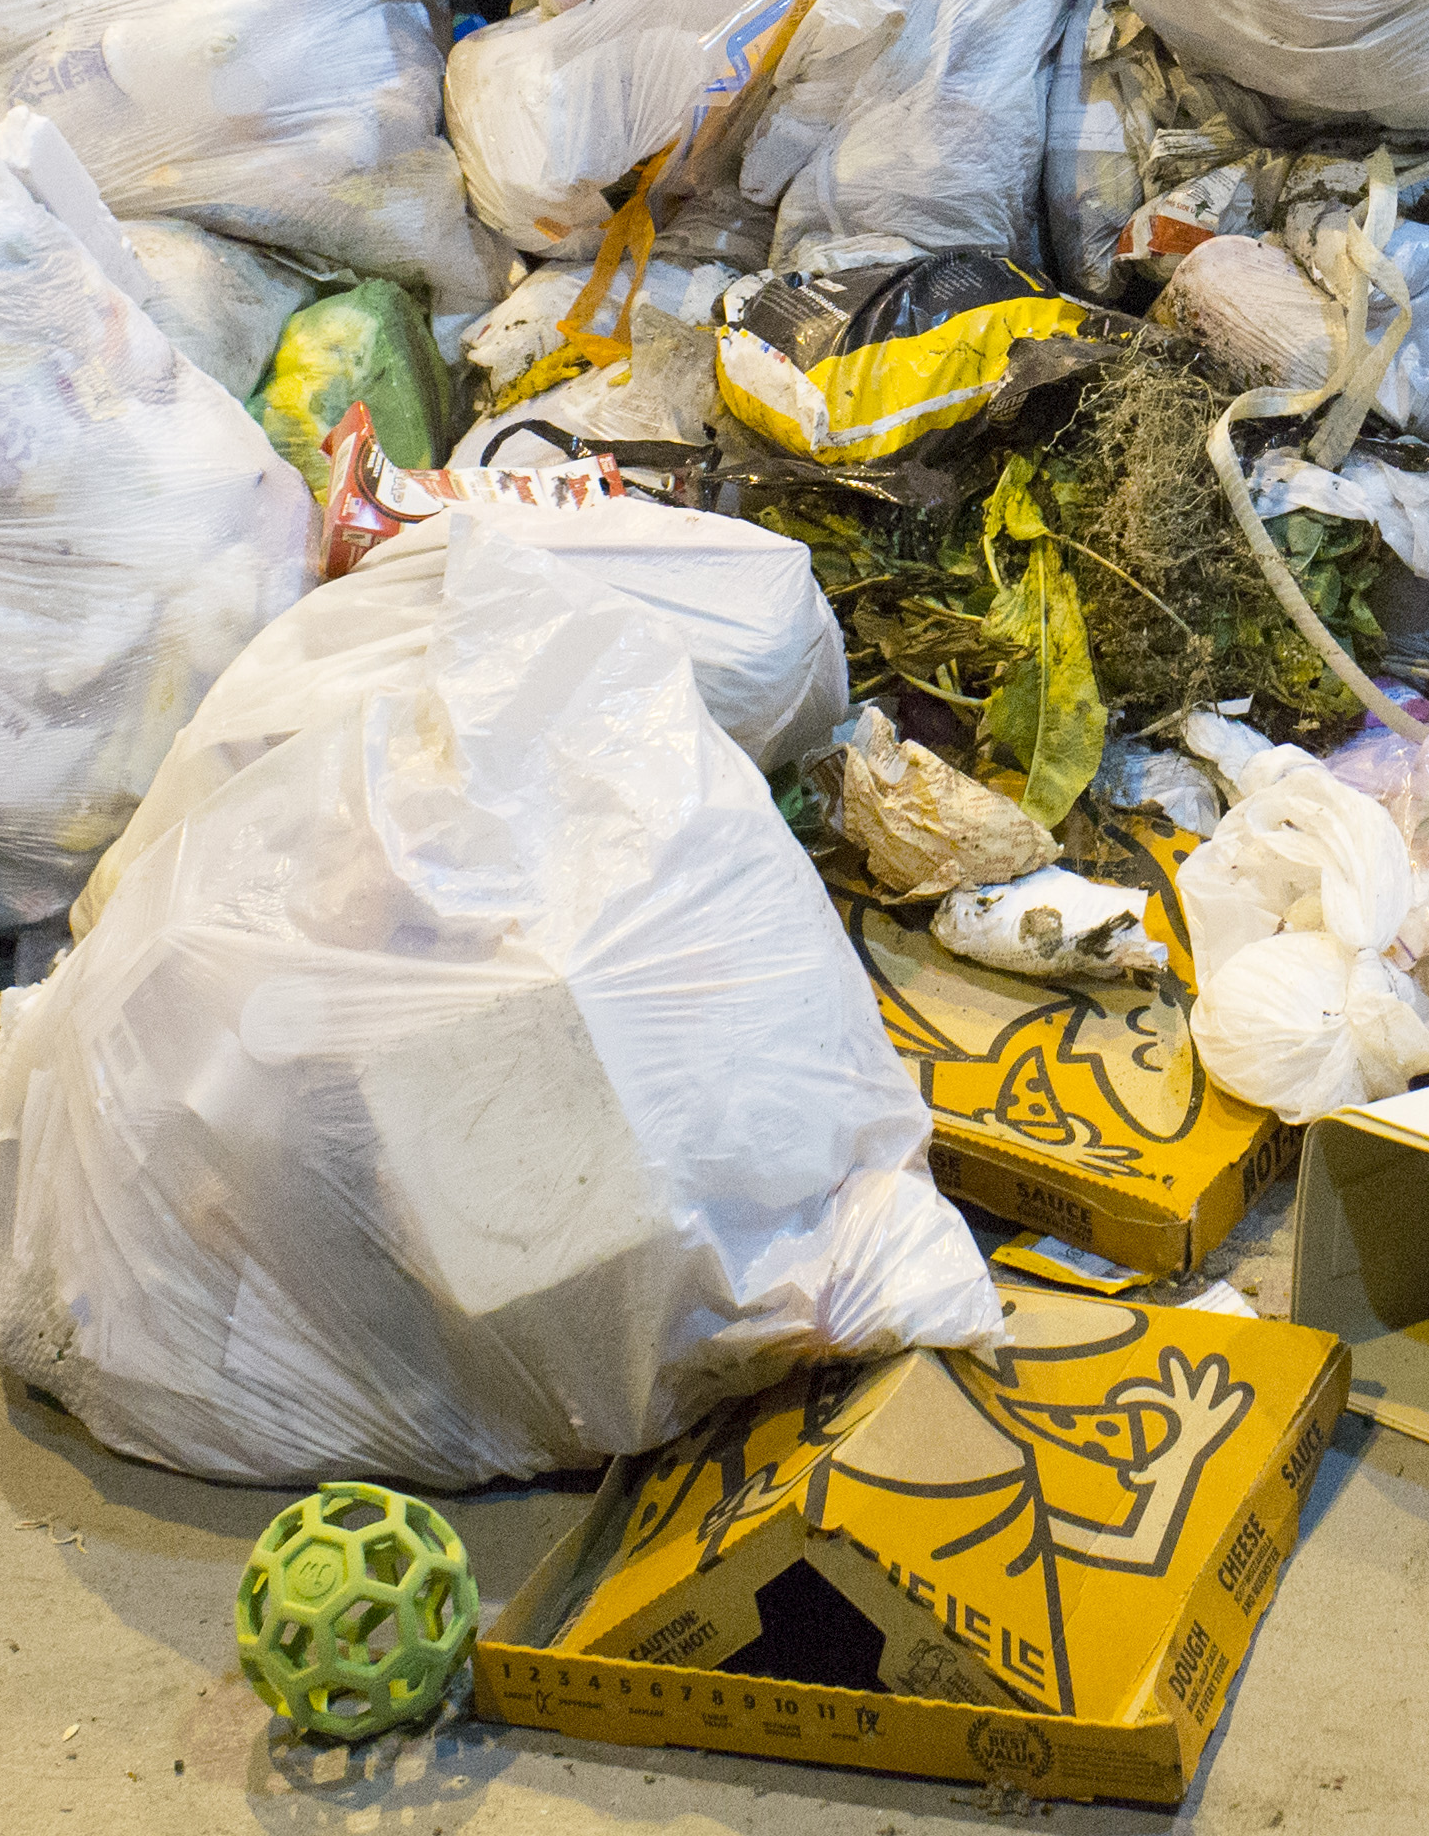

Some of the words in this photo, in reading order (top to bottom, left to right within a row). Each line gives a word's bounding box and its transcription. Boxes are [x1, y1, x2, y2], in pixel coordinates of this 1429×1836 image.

[1281, 1419, 1324, 1489] SAUCE
[1218, 1514, 1267, 1592] CHEESE
[1243, 1535, 1273, 1586] MOZZARELLA
[1251, 1544, 1282, 1600] MUENSTER
[628, 1610, 700, 1662] CAUTION:
[1168, 1619, 1211, 1702] DOUGH
[503, 1664, 512, 1679] 1
[529, 1667, 542, 1682] 2
[558, 1671, 570, 1686] 3
[588, 1675, 602, 1690] 4
[619, 1679, 631, 1694] 5
[650, 1682, 663, 1698] 6
[680, 1686, 693, 1701] 7
[712, 1690, 724, 1706] 8
[744, 1694, 756, 1710] 9
[774, 1698, 799, 1715] 10
[817, 1704, 837, 1720] 11
[1200, 1681, 1219, 1716] EVERY
[1211, 1653, 1231, 1687] STORE
[987, 1733, 1027, 1752] BEST
